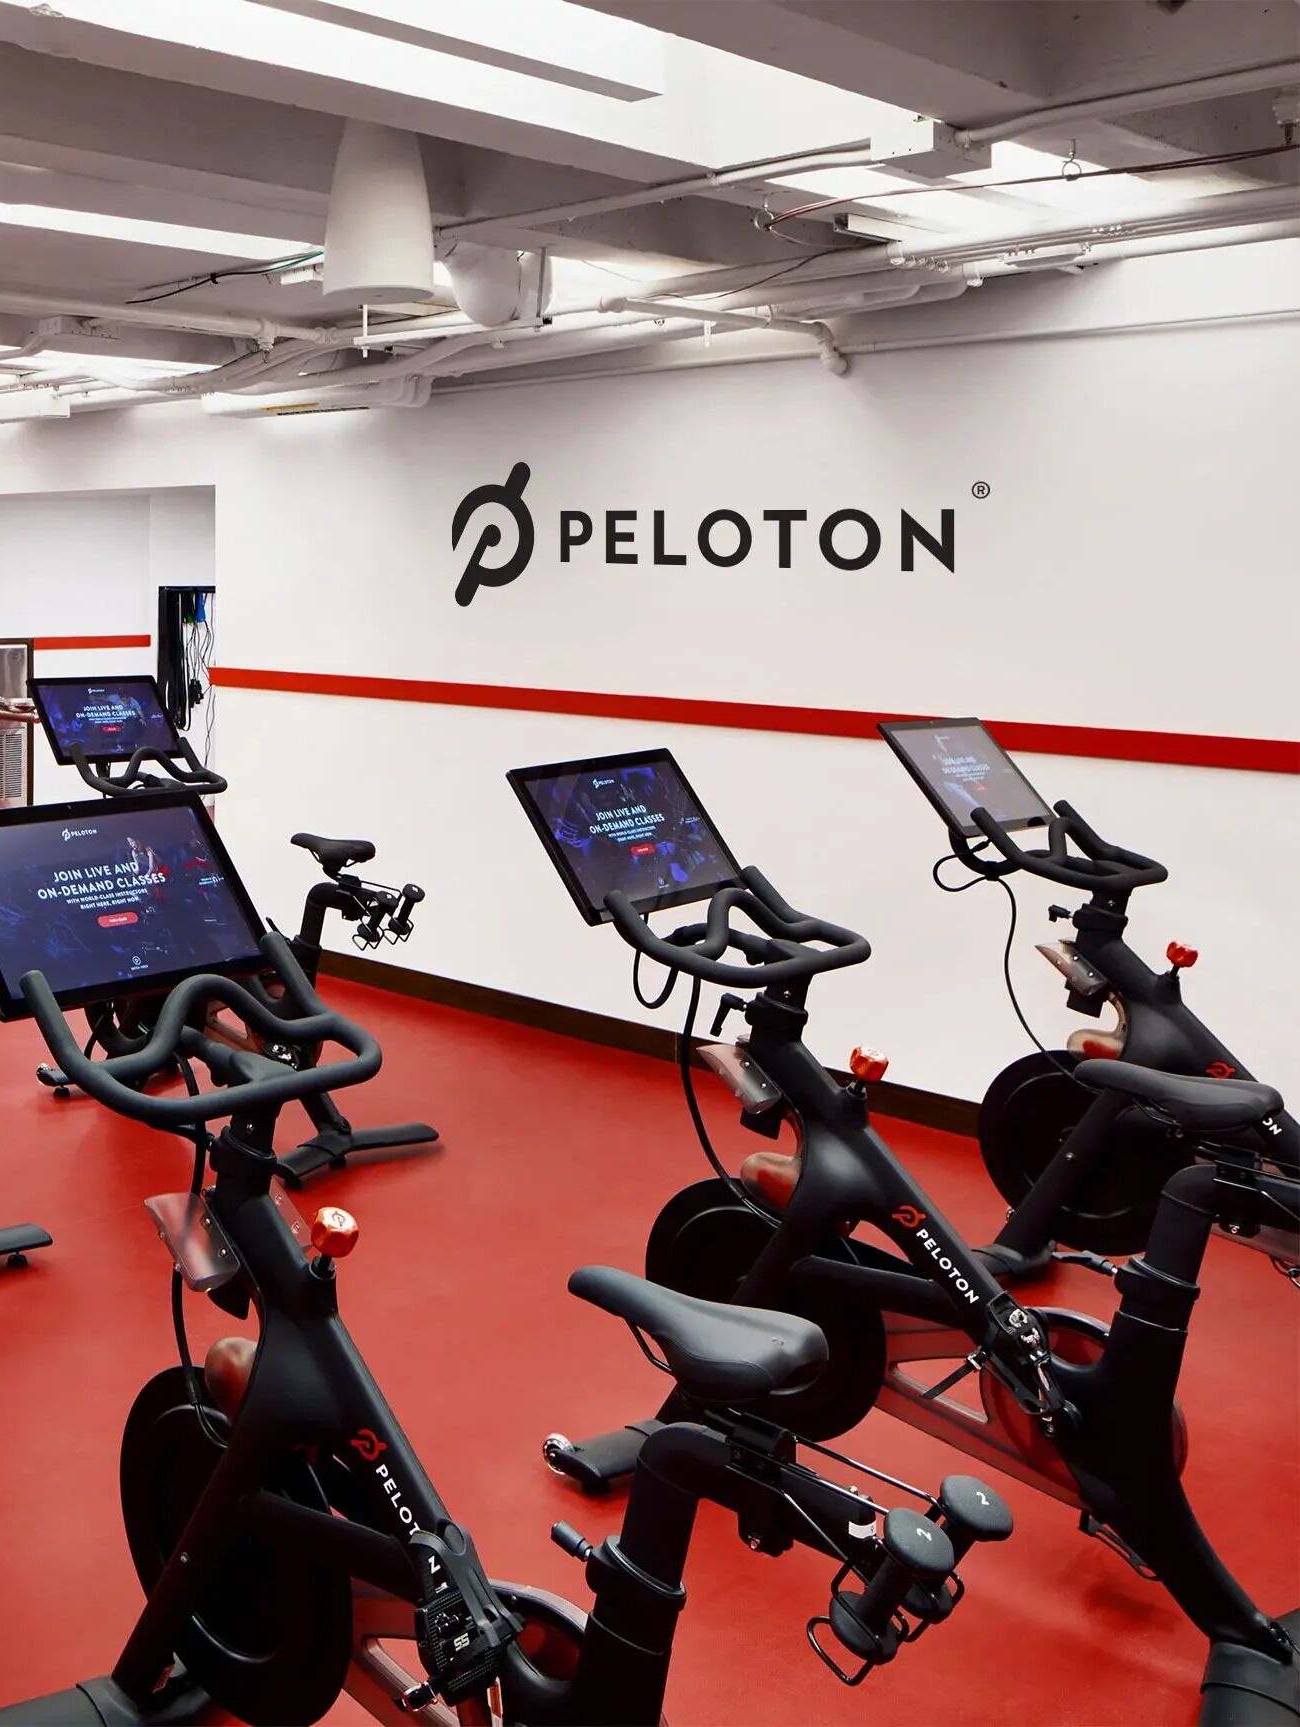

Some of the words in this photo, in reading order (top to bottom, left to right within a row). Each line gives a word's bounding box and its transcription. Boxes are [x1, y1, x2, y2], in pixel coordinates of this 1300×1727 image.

[560, 508, 955, 574] PELOTON
[589, 818, 635, 834] ON-DEMAND
[634, 813, 665, 826] CLASSES
[595, 810, 614, 821] JOIN
[612, 807, 631, 818] LIVE
[631, 804, 647, 814] AND
[71, 828, 97, 837] PELOTON
[53, 869, 83, 883] JOIN
[84, 865, 112, 879] LIVE
[114, 861, 139, 875] AND
[37, 880, 114, 899] ON-DEMAND
[117, 872, 166, 888] CLASSES
[916, 1228, 980, 1304] PELOTON
[375, 1463, 441, 1574] PELOTN
[916, 1527, 932, 1541] 2
